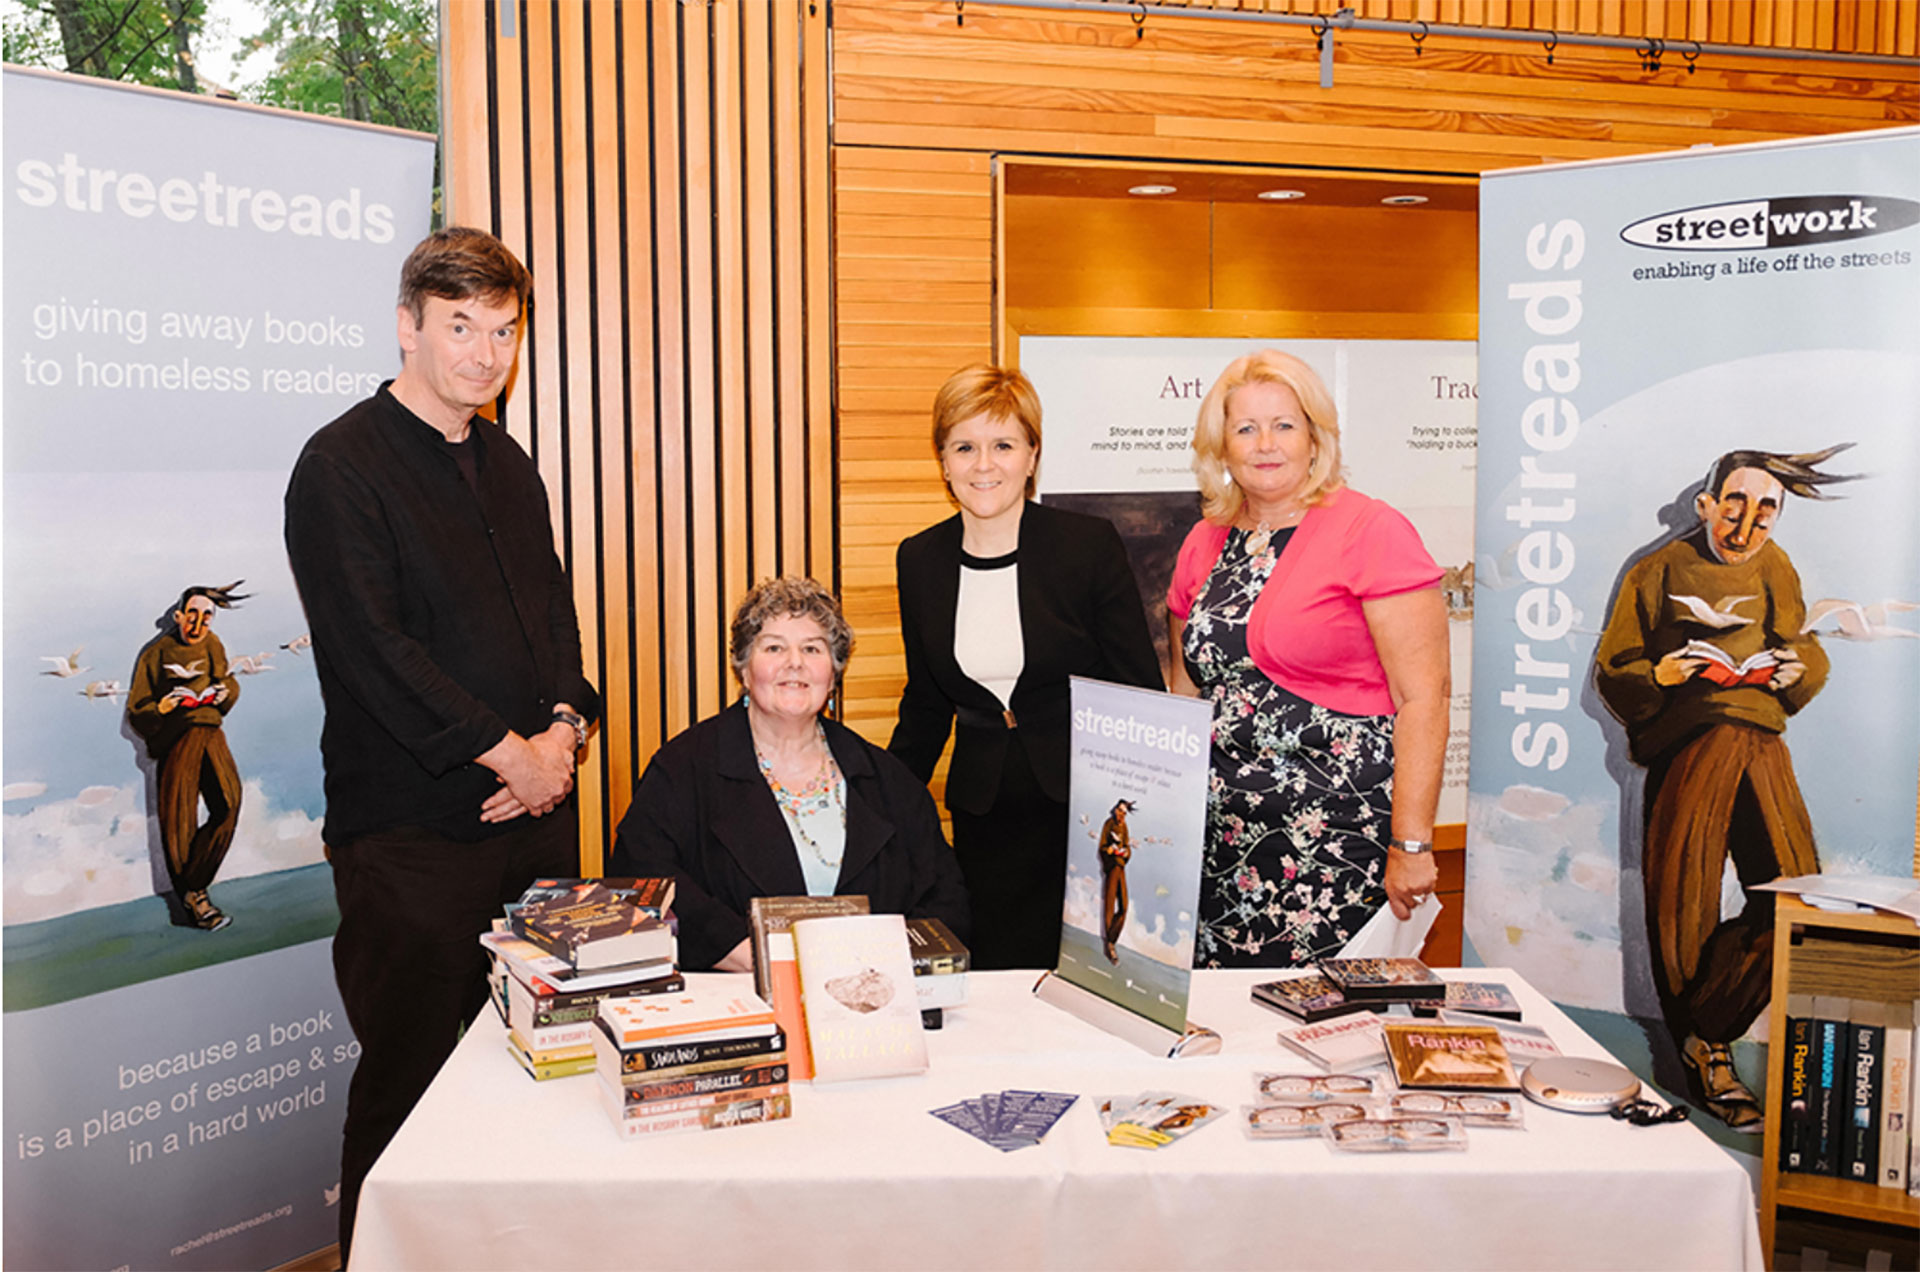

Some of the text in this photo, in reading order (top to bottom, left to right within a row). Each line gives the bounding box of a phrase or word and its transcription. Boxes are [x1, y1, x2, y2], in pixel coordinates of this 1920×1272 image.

[16, 152, 395, 244] streetreads
[1656, 201, 1878, 243] streetwork
[1633, 250, 1911, 281] enabling a life off the streets
[33, 297, 365, 349] giving away books
[21, 352, 381, 396] to homeless readers
[1159, 375, 1203, 399] Art
[1091, 441, 1119, 451] mind
[1121, 441, 1132, 451] to
[1166, 441, 1187, 451] and
[1109, 425, 1188, 437] Stories are told
[1442, 427, 1452, 436] to
[1447, 441, 1454, 449] a
[1500, 218, 1586, 772] streetreads
[1073, 706, 1201, 758] streetreads
[118, 1009, 333, 1090] because a book
[1407, 1034, 1486, 1049] Rankin
[1792, 1023, 1808, 1096] Ian Rankin
[695, 1075, 743, 1092] PARALLEL
[1856, 1029, 1875, 1106] Ian Rankin
[1889, 1058, 1907, 1110] Rankin
[18, 1133, 44, 1160] is
[54, 1127, 73, 1150] a
[82, 1101, 161, 1147] place
[170, 1082, 199, 1113] of
[205, 1057, 300, 1102] escape
[308, 1046, 326, 1072] &
[129, 1080, 326, 1166] in a hard world
